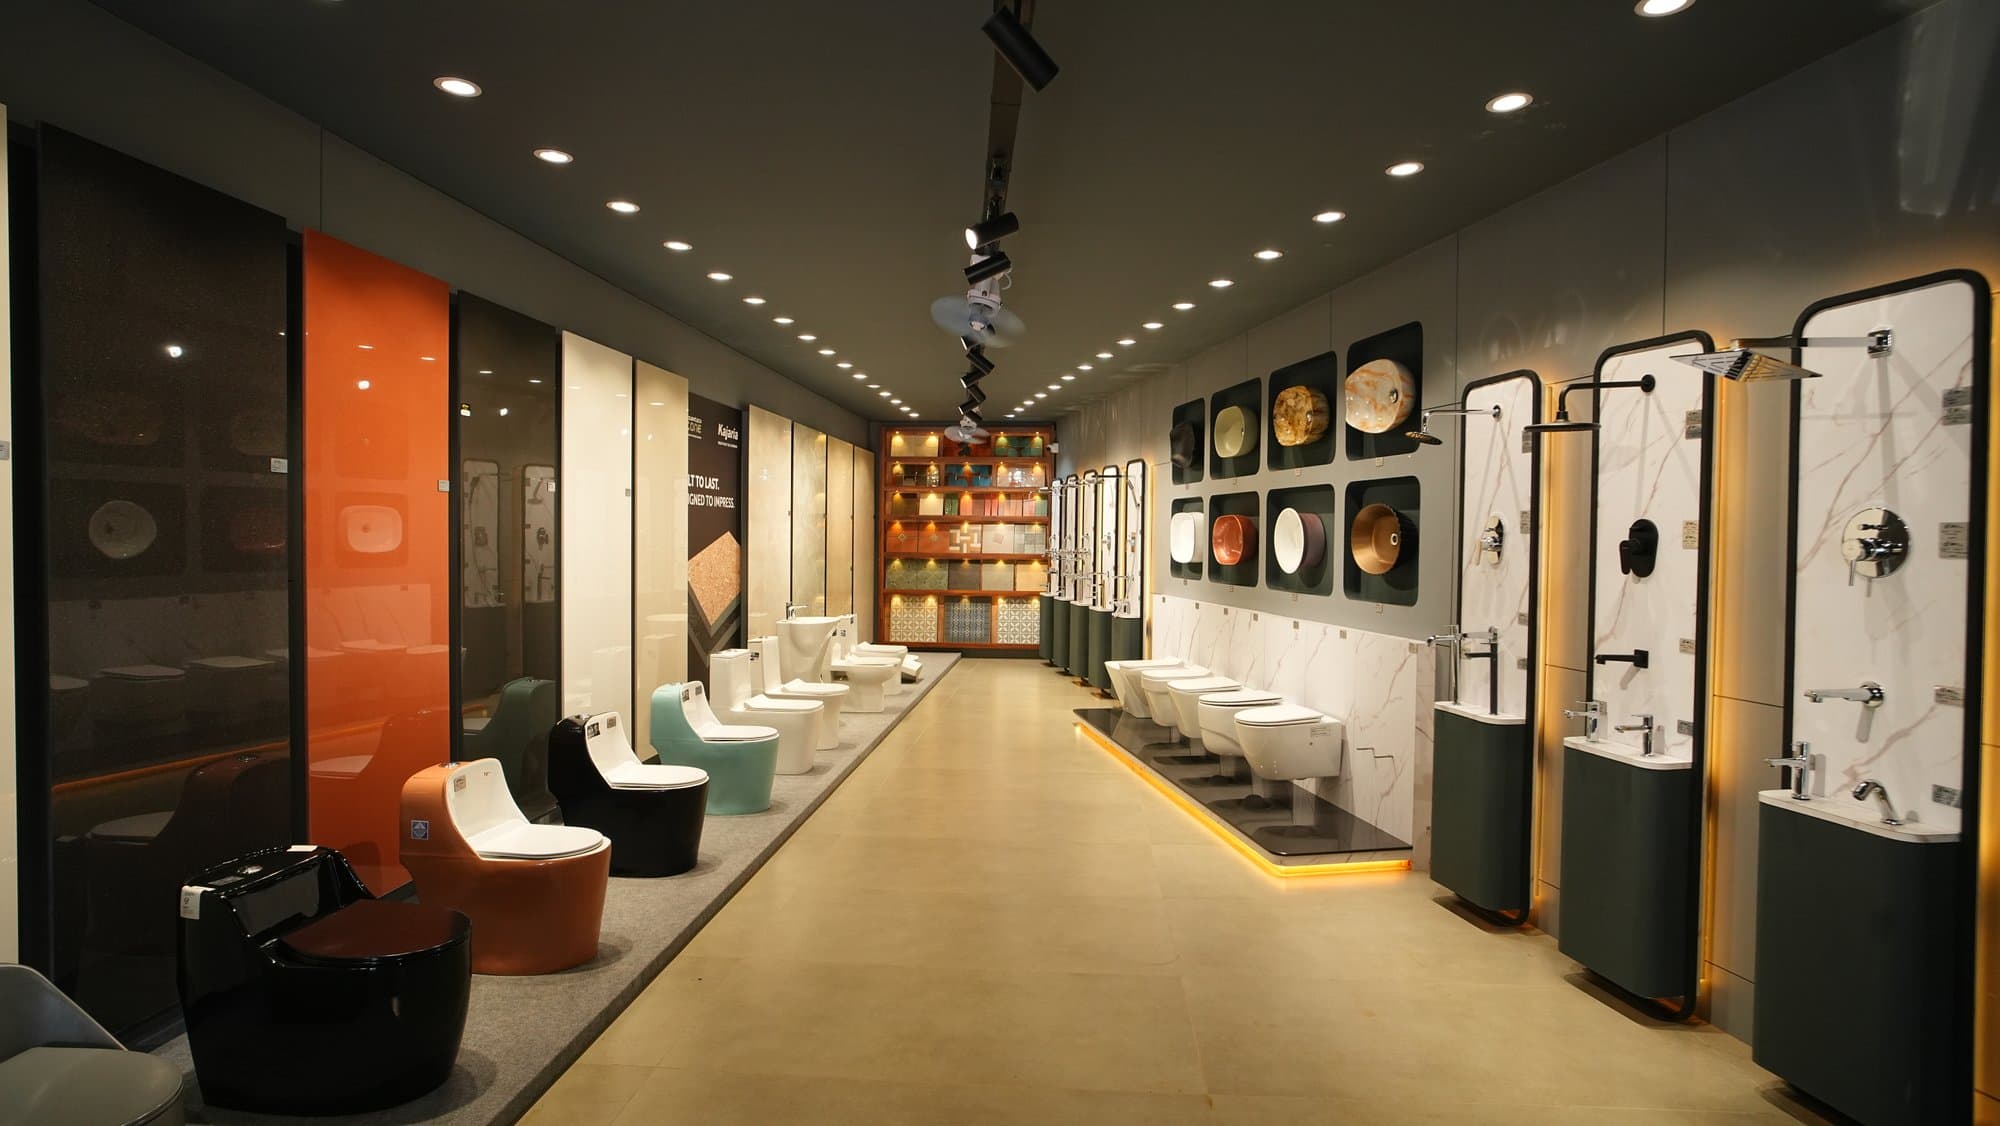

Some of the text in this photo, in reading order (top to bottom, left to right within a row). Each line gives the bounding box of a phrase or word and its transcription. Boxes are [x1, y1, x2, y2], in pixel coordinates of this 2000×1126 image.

[717, 423, 739, 441] Kajaria
[696, 475, 705, 489] TO
[705, 476, 720, 490] LAST.
[706, 495, 714, 507] TO
